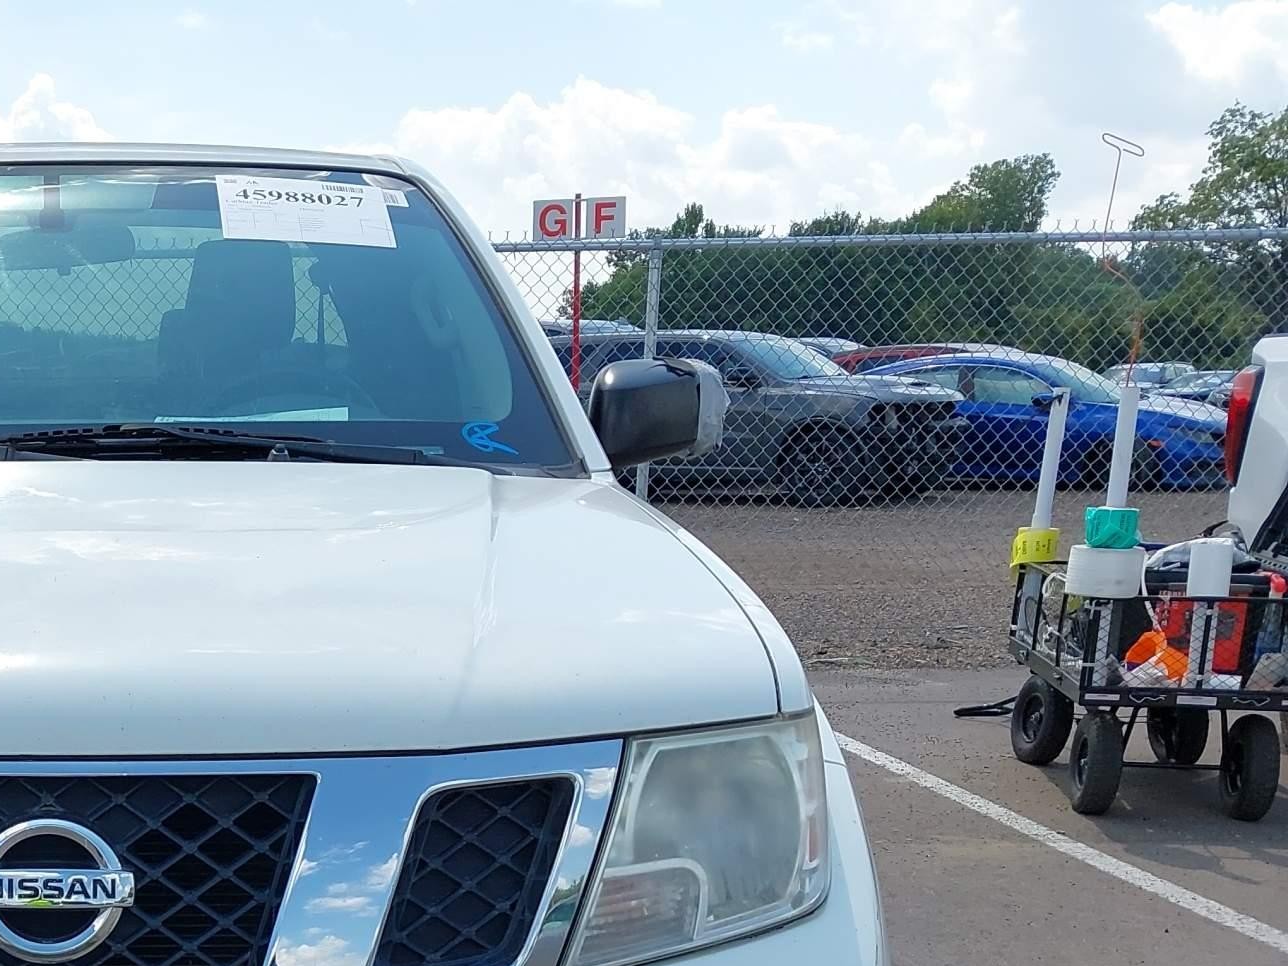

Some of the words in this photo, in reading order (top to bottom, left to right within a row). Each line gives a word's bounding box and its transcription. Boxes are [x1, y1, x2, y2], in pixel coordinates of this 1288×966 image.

[235, 188, 364, 208] 45988027
[538, 203, 568, 238] G
[593, 201, 617, 235] F
